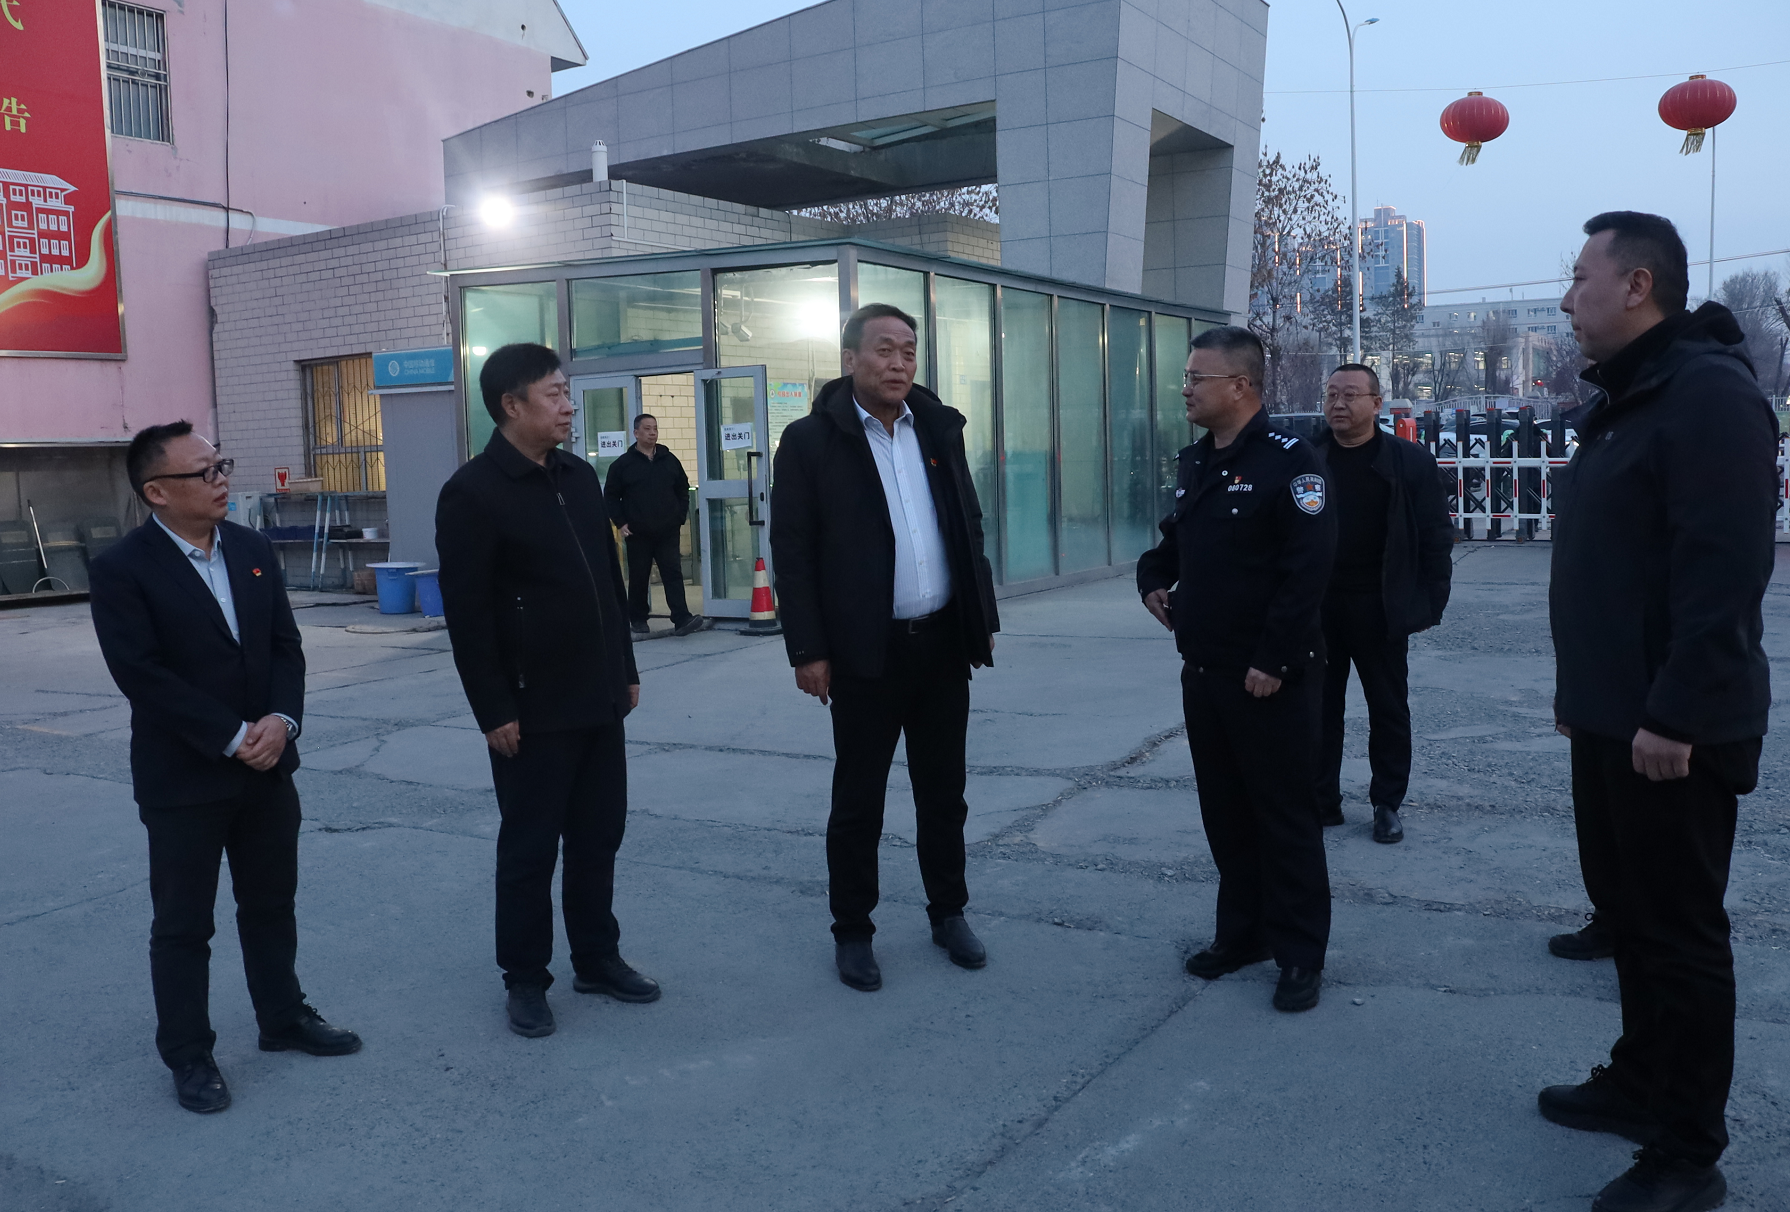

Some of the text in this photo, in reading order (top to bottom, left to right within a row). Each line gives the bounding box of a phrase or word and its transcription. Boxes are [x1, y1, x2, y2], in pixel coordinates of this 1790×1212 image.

[0, 97, 31, 133] 告
[724, 432, 750, 441] 进出关门
[600, 439, 624, 448] 进出关门
